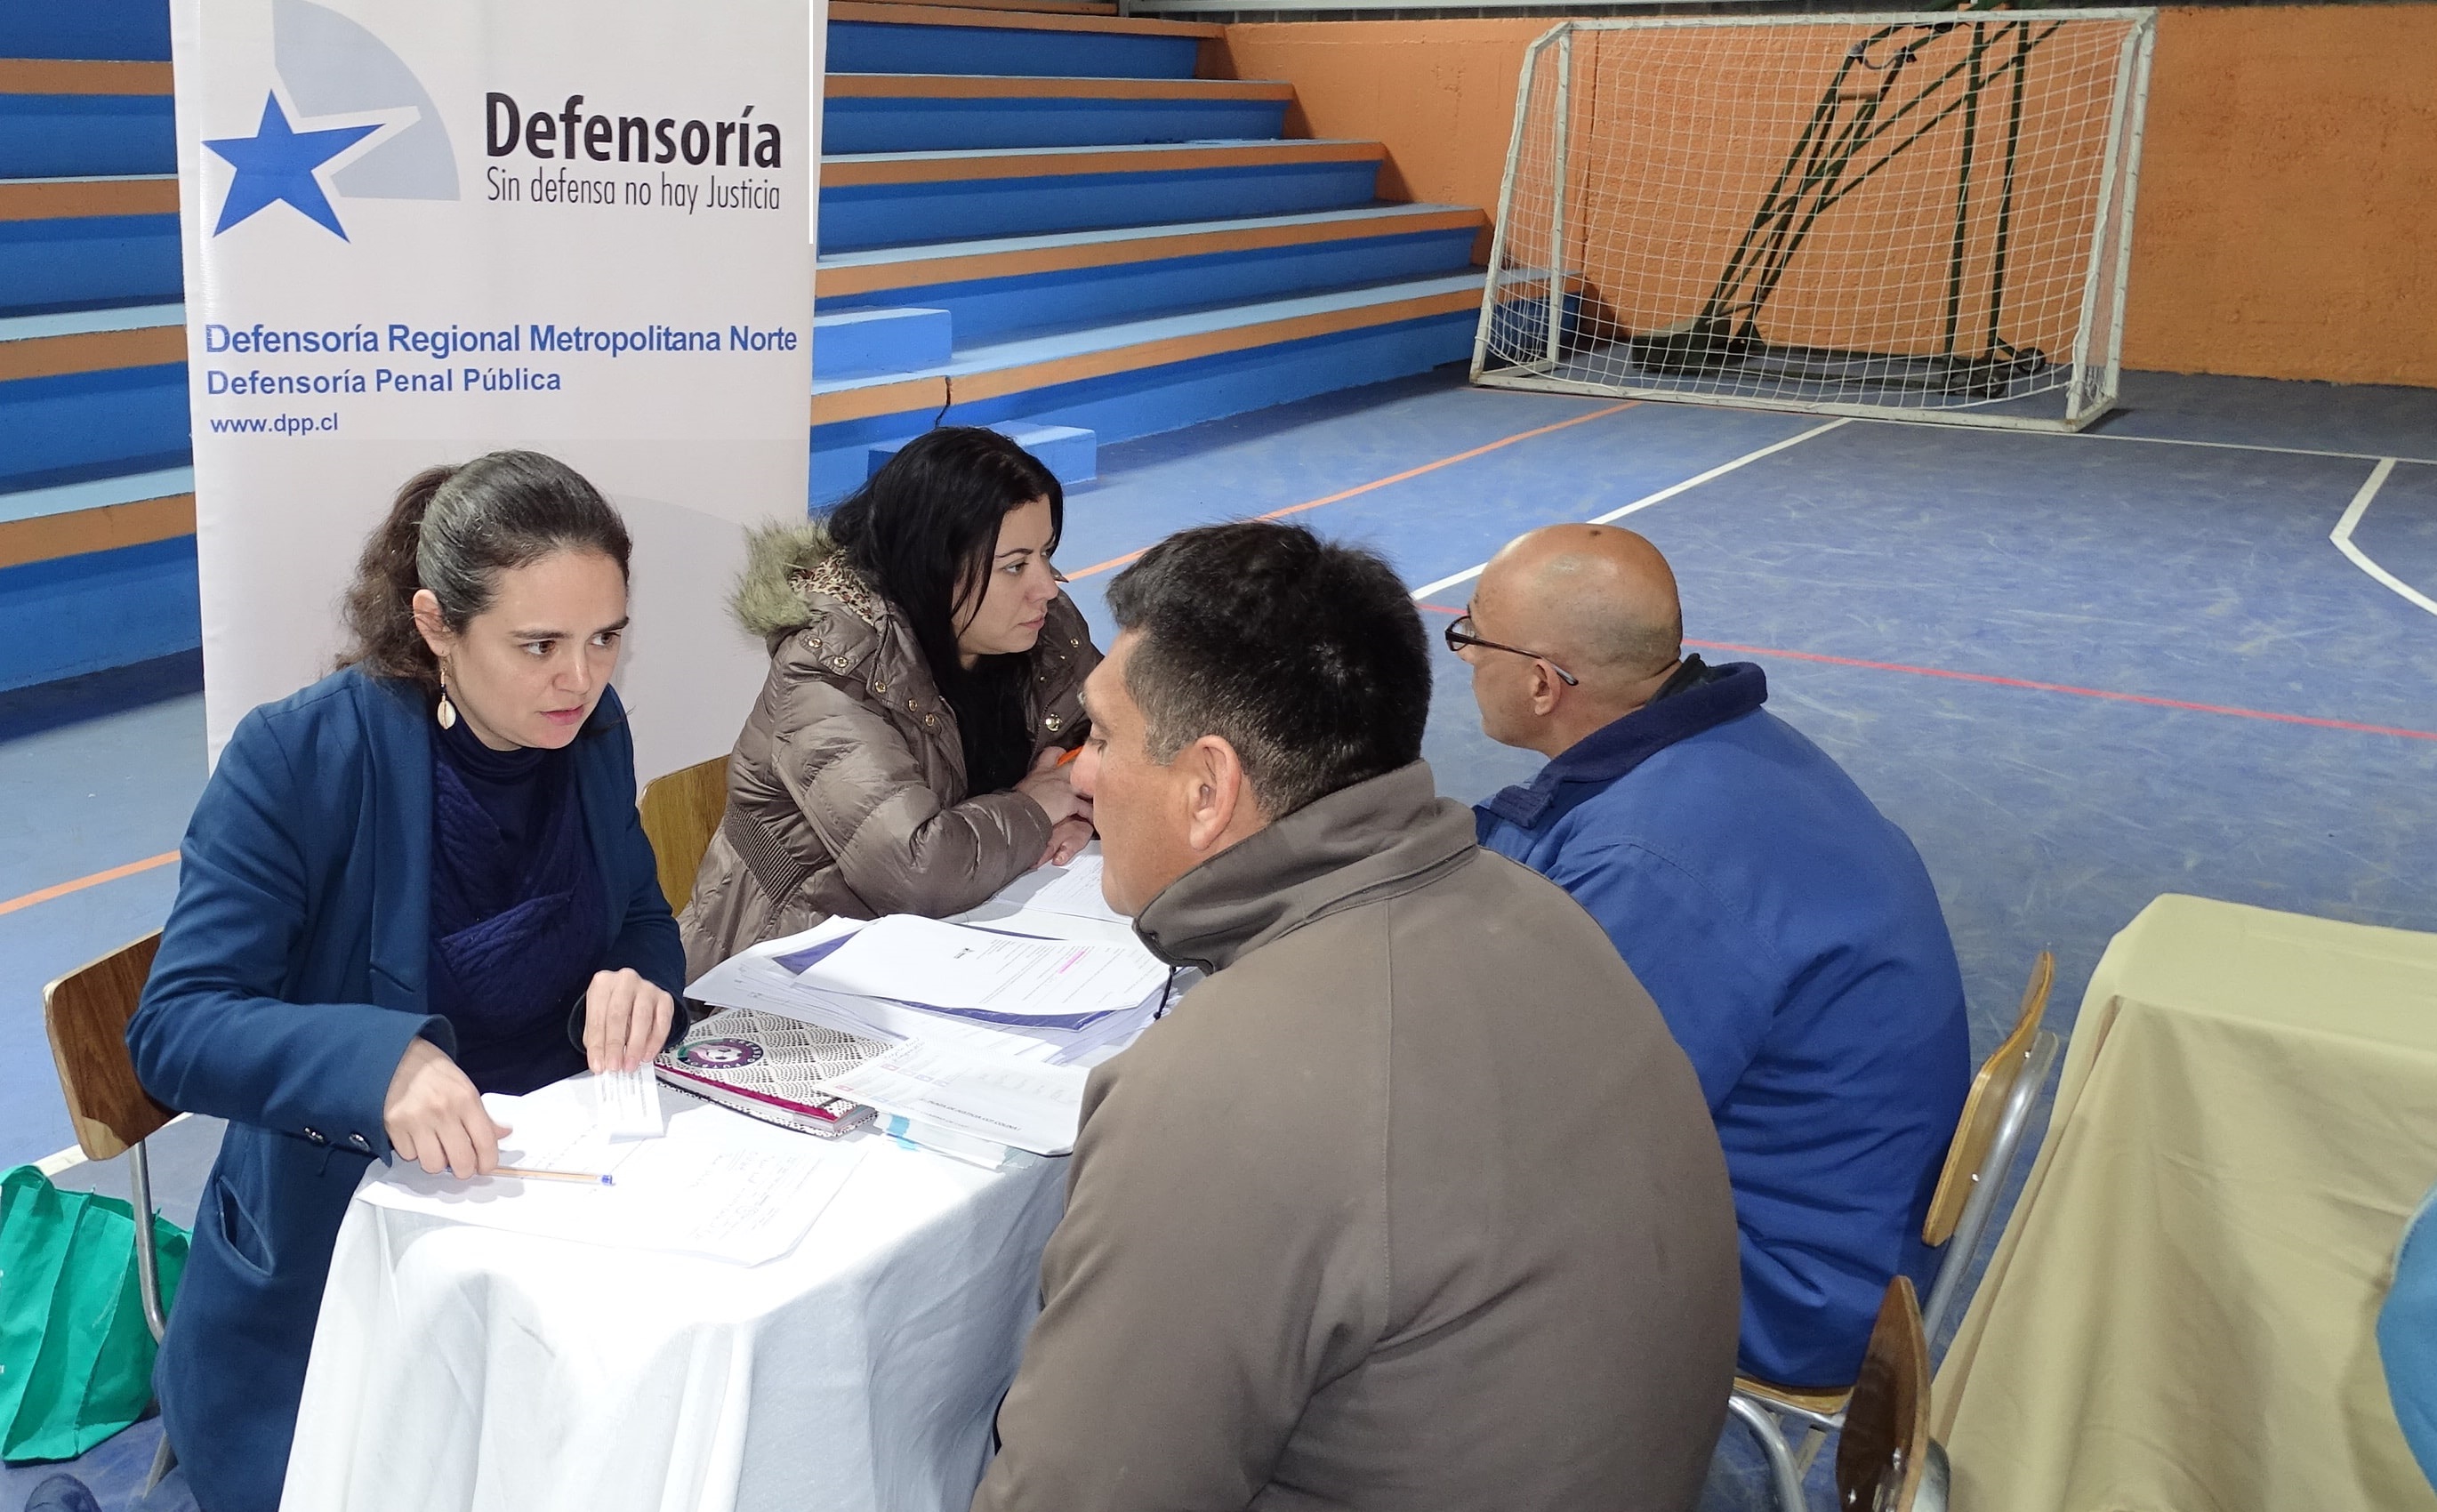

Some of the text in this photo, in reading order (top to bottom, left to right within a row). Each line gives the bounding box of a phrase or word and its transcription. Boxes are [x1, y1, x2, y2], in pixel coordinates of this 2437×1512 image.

[486, 92, 782, 169] Defensoría
[487, 165, 781, 216] Sin defensa no hay Justicia
[205, 323, 799, 360] Defensoría Regional Metropolitana Norte
[207, 366, 562, 396] Defensoría Penal Pública
[210, 411, 339, 438] www.dpp.cl
